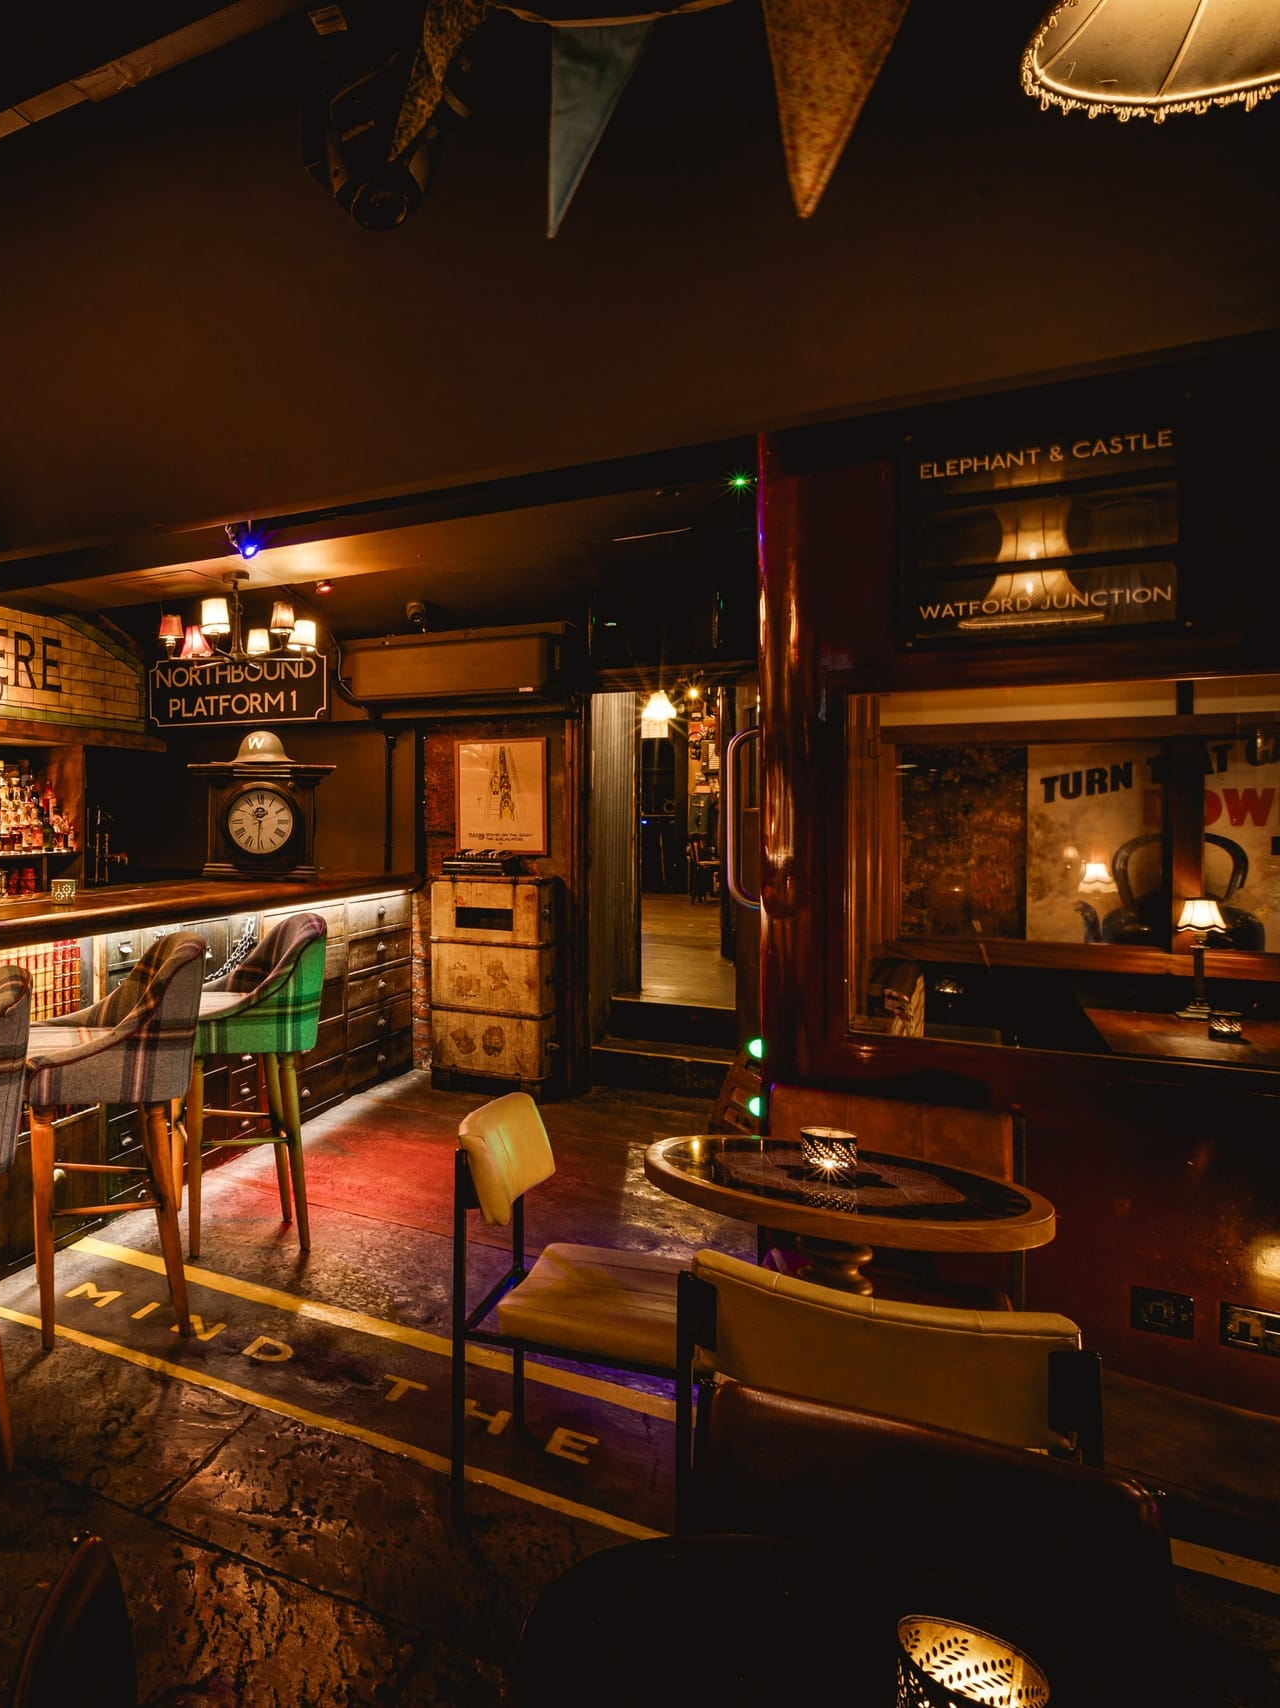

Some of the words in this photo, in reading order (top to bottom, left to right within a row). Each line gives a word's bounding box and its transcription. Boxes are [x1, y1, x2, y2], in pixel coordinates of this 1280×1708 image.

[920, 447, 1041, 480] ELEPHANT
[1049, 446, 1064, 463] &
[1072, 429, 1173, 459] CASTLE
[920, 592, 1034, 620] WATFORD
[1040, 584, 1173, 612] JUNCTION
[155, 656, 317, 689] NORTHBOUND
[169, 690, 284, 719] PLATFORM
[290, 690, 297, 712] 1
[248, 737, 265, 750] W
[1040, 761, 1133, 804] TURN
[64, 1281, 294, 1363] MIND
[383, 1373, 600, 1466] THE
